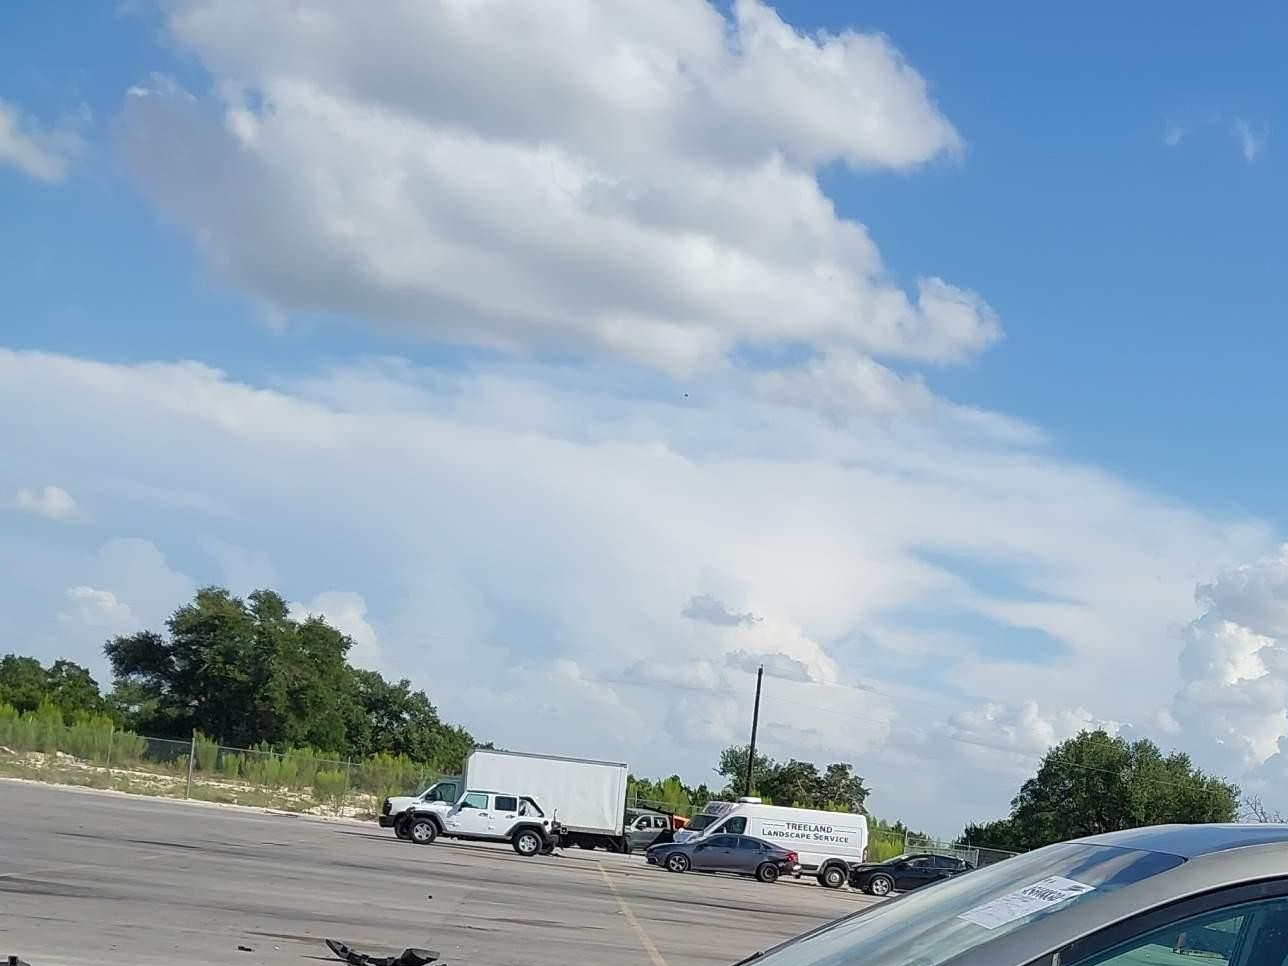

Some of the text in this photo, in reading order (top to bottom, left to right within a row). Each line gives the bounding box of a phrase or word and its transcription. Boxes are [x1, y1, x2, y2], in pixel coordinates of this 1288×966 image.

[786, 822, 833, 834] TREELAND
[762, 828, 849, 843] LANDSCAPE SERVICE
